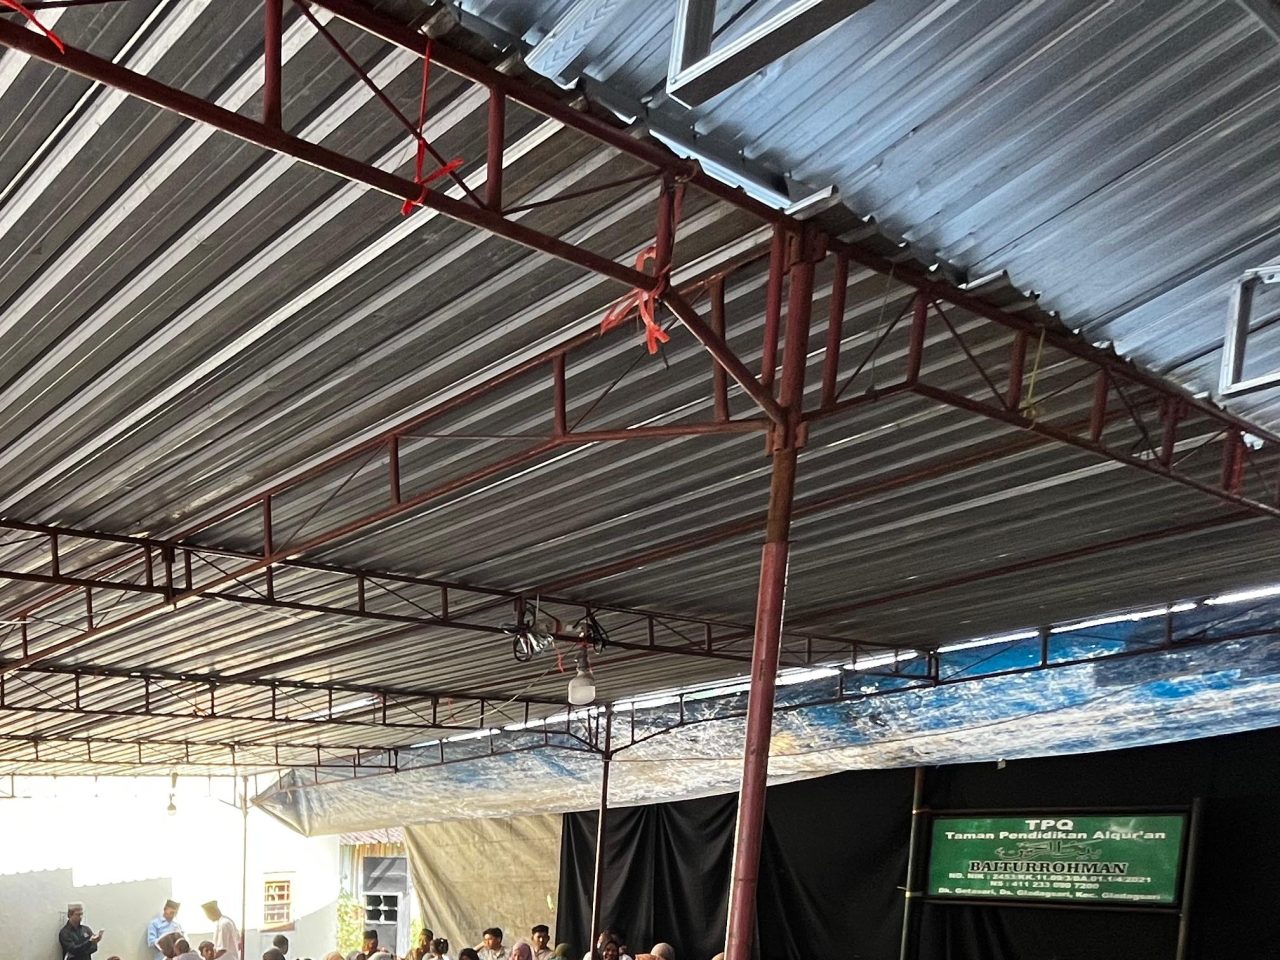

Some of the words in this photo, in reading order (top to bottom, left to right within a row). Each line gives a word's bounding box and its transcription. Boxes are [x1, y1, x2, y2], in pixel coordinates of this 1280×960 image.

[1025, 819, 1074, 831] TPQ
[945, 831, 995, 840] Taman
[999, 831, 1088, 840] Pendidikan
[1092, 830, 1166, 841] Alqur'an
[968, 860, 1129, 876] BAITURROHMAN
